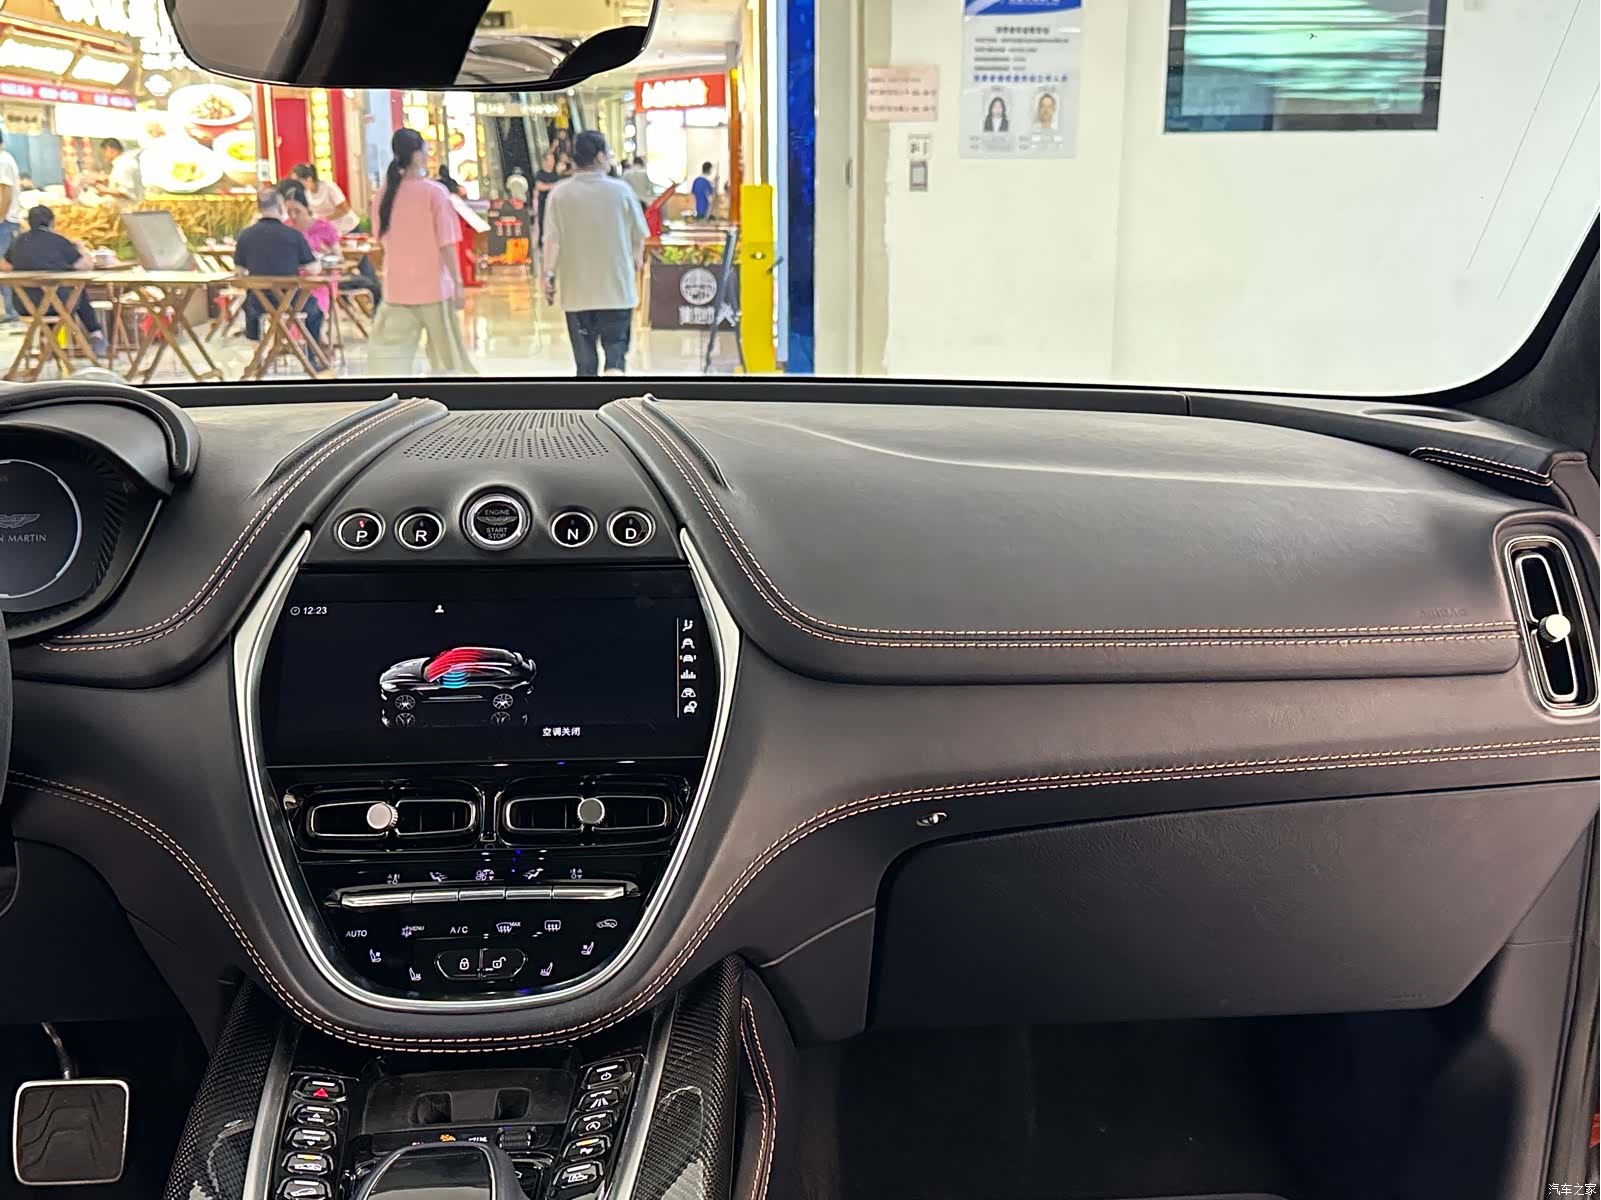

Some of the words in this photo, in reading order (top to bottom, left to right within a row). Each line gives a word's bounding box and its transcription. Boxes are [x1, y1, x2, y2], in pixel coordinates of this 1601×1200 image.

[8, 534, 47, 542] MARTIN
[356, 530, 368, 542] P
[415, 530, 427, 542] R
[567, 528, 579, 540] N
[625, 527, 637, 540] D
[303, 606, 328, 615] 12:23
[542, 726, 581, 737] 空调关闭
[345, 929, 368, 938] AUTO
[449, 925, 469, 934] A/C
